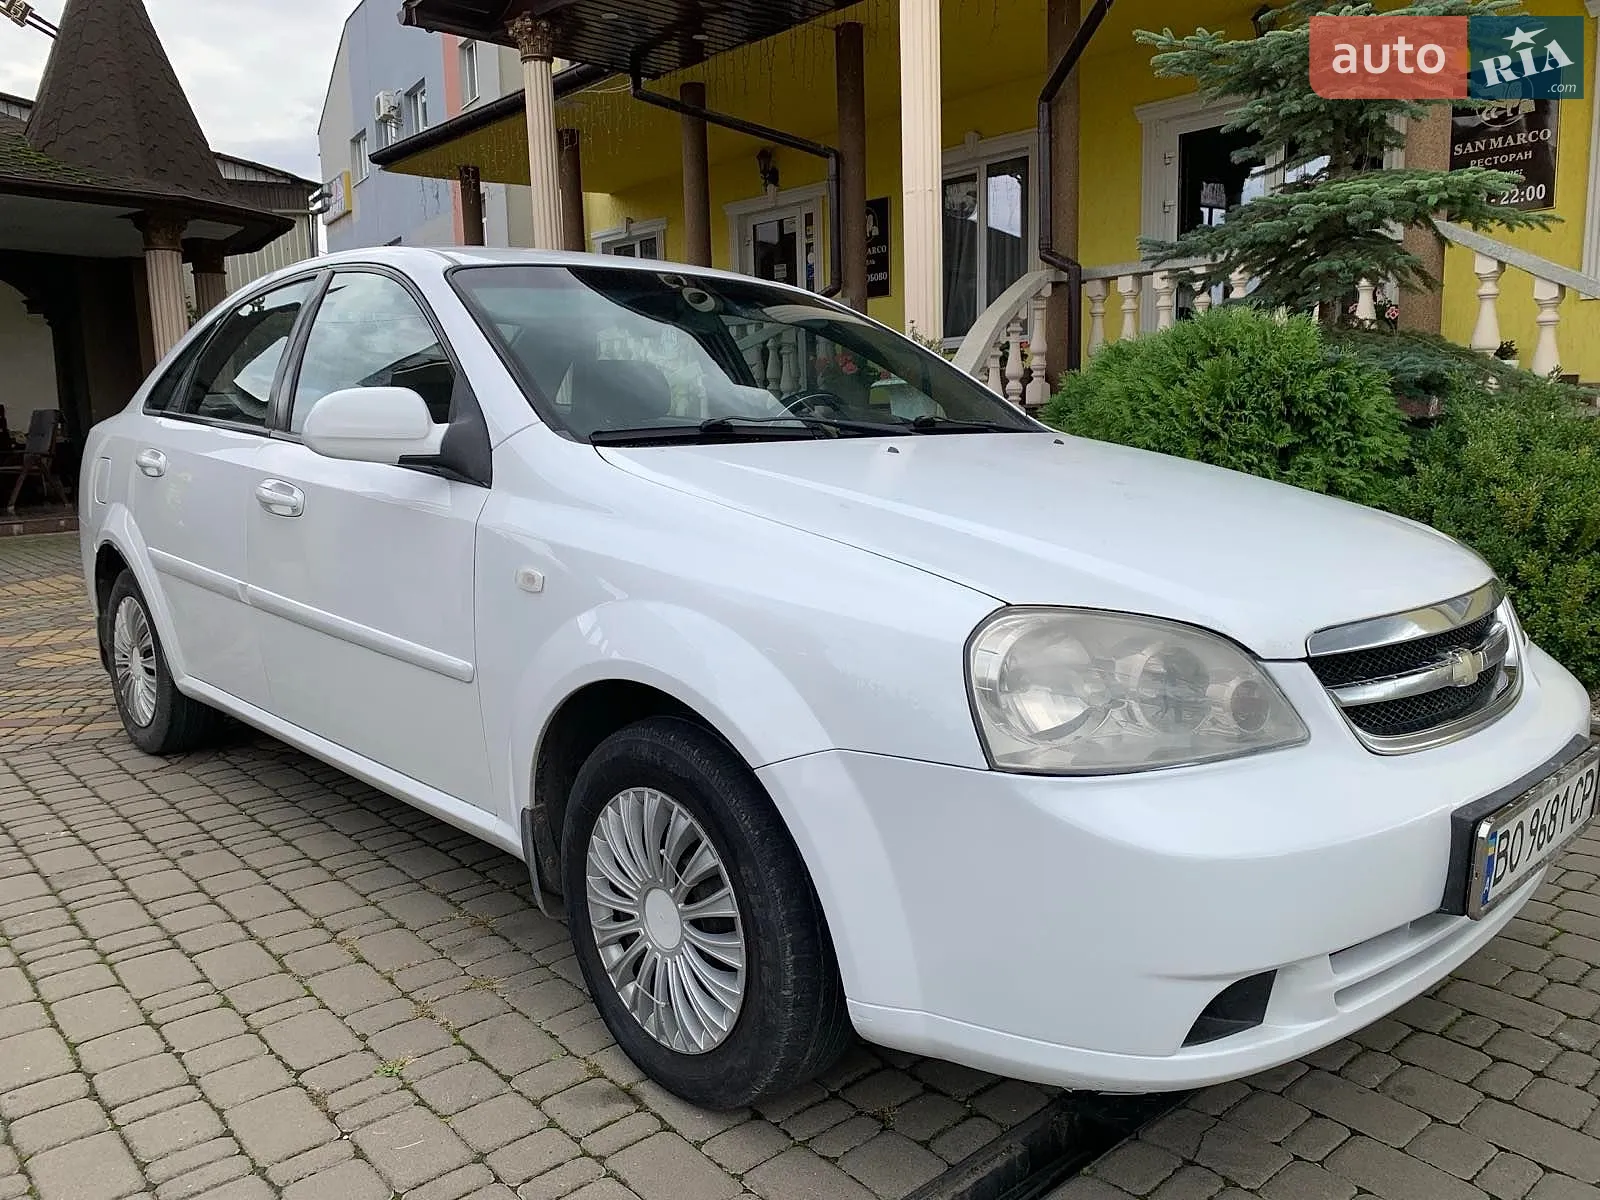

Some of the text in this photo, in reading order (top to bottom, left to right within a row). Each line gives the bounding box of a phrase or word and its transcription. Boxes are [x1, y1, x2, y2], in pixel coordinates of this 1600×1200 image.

[1454, 128, 1552, 156] SAN MARCO
[1470, 150, 1533, 167] РЕСТОРАН
[1499, 183, 1546, 205] 22:00
[866, 244, 887, 256] ARCO
[1493, 768, 1594, 887] BO 9681 CP
